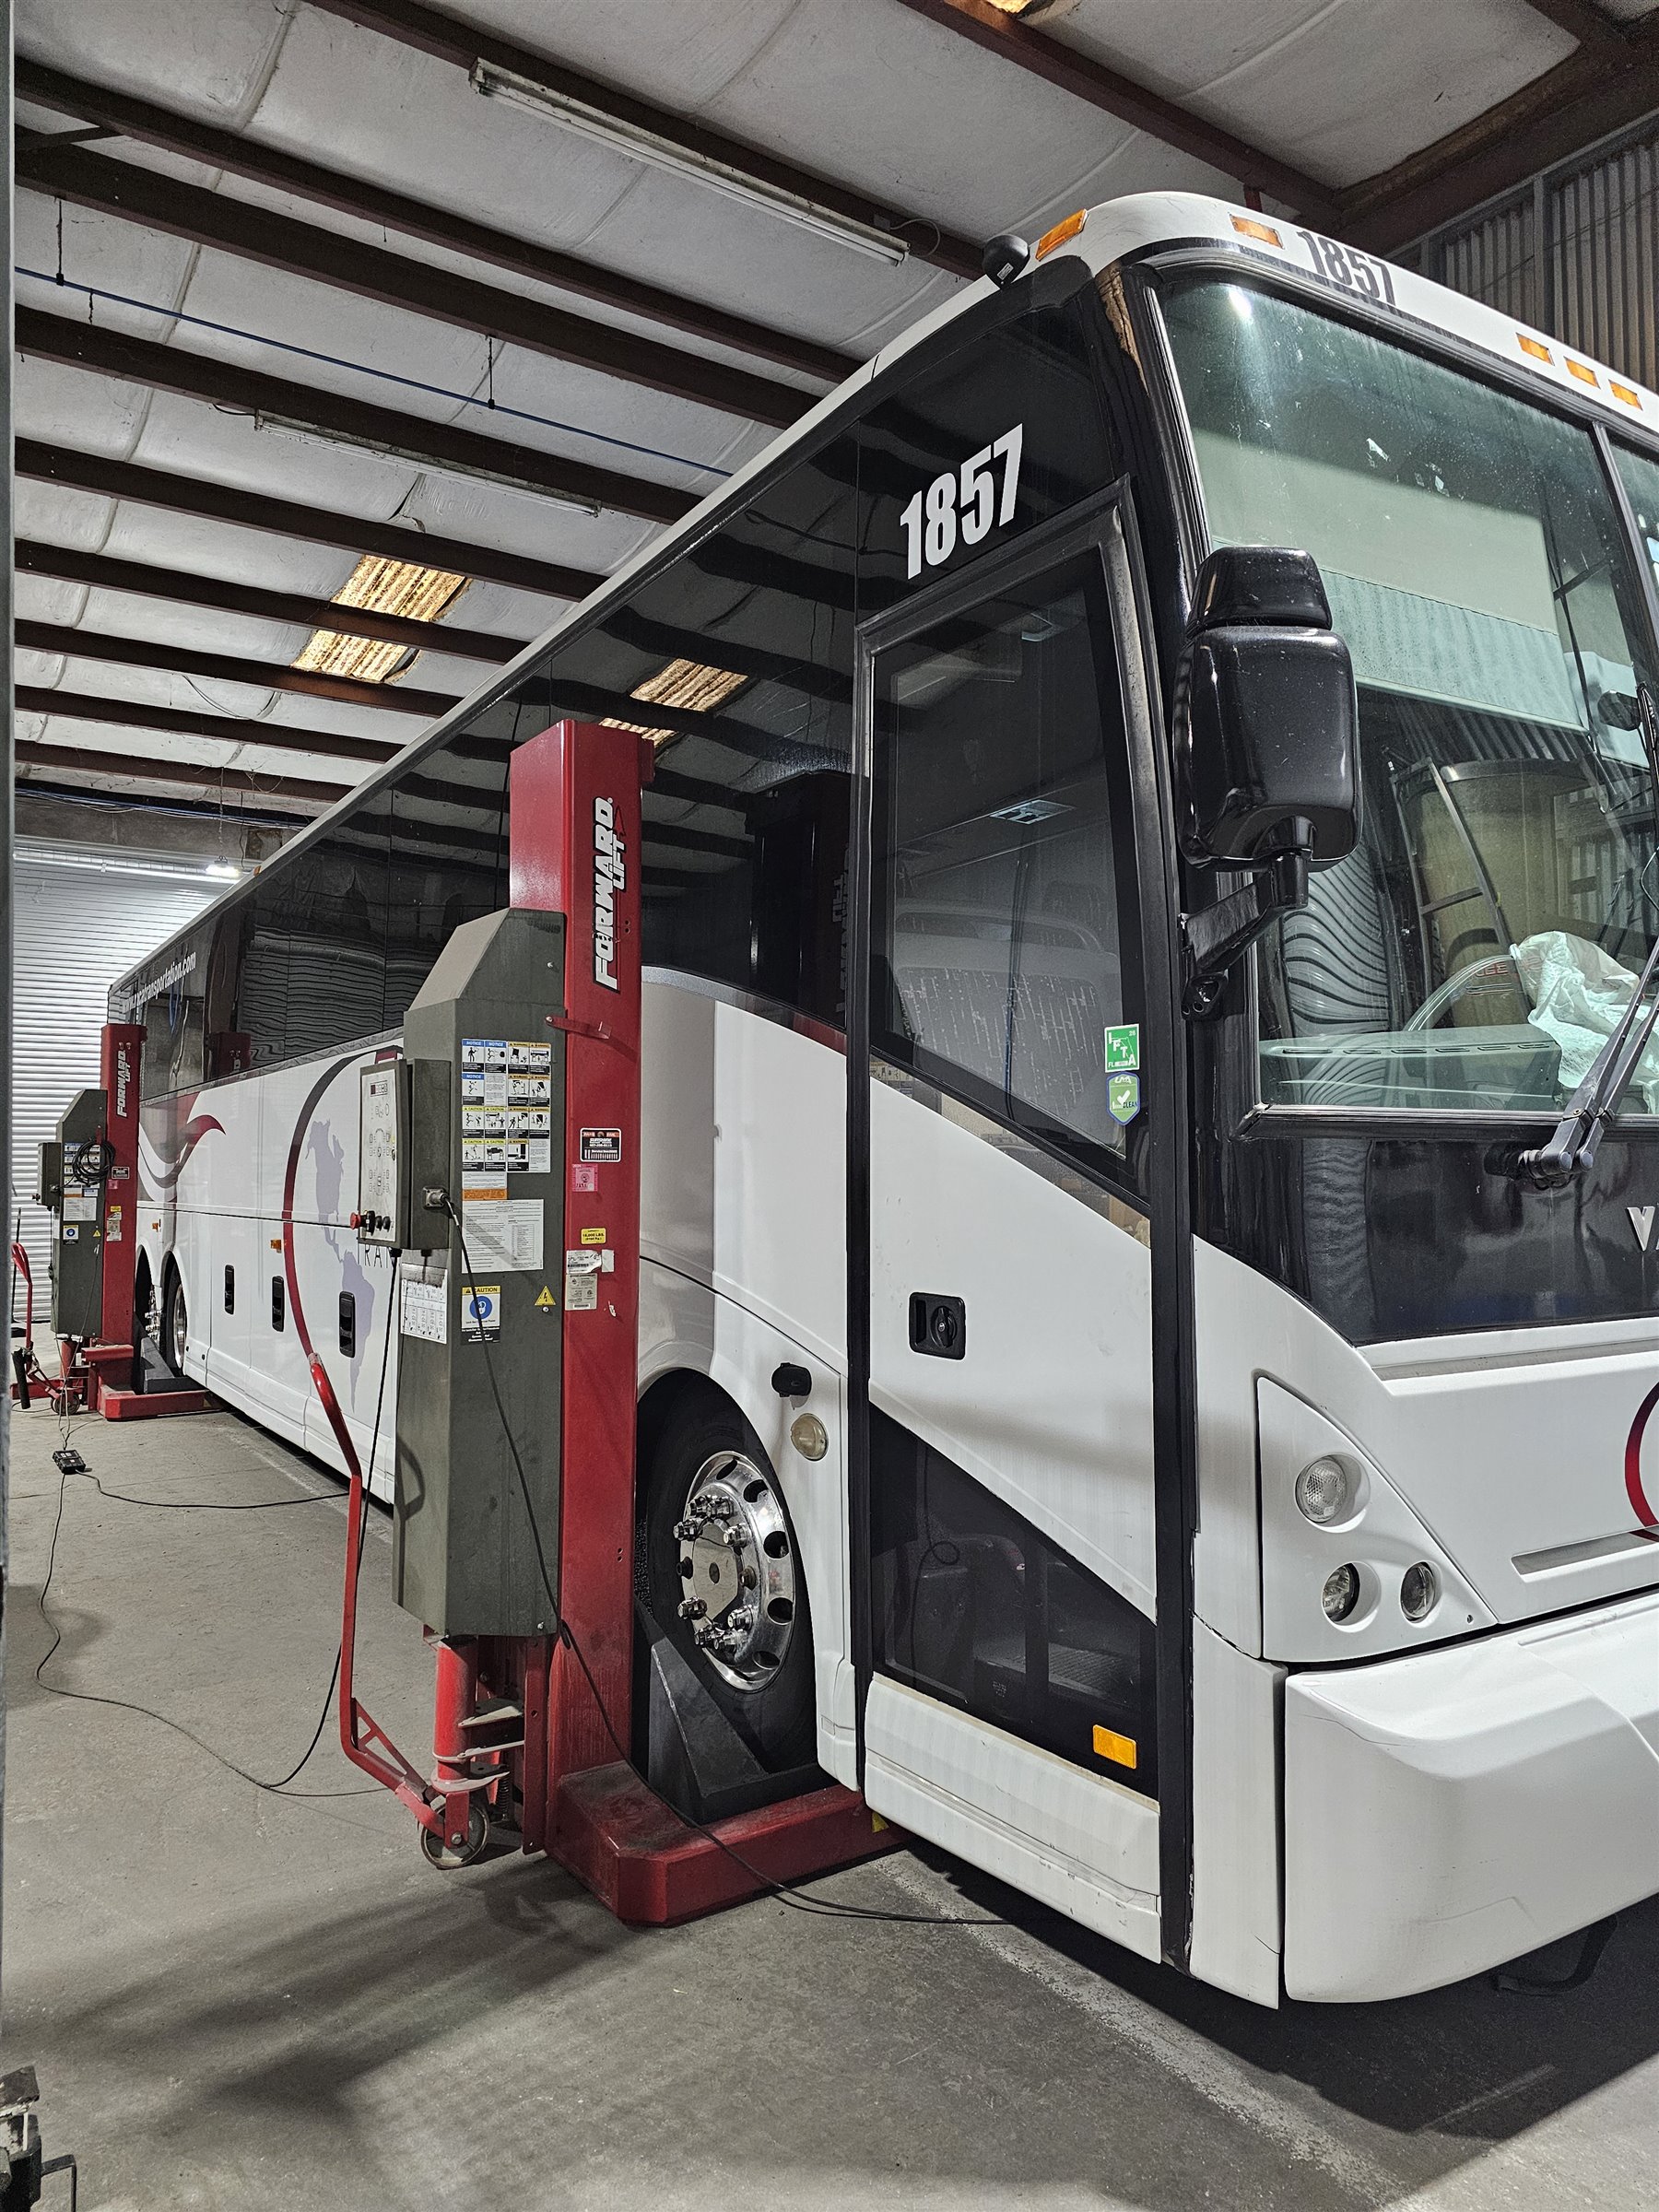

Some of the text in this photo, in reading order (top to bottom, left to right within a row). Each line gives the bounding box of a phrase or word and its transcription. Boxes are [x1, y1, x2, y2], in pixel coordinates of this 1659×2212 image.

[1296, 230, 1396, 306] 1857
[900, 423, 1023, 580] 1857
[594, 796, 618, 991] FORWARD
[607, 833, 625, 890] LIFT
[117, 1050, 127, 1117] FORWARD
[1627, 1206, 1659, 1251] V
